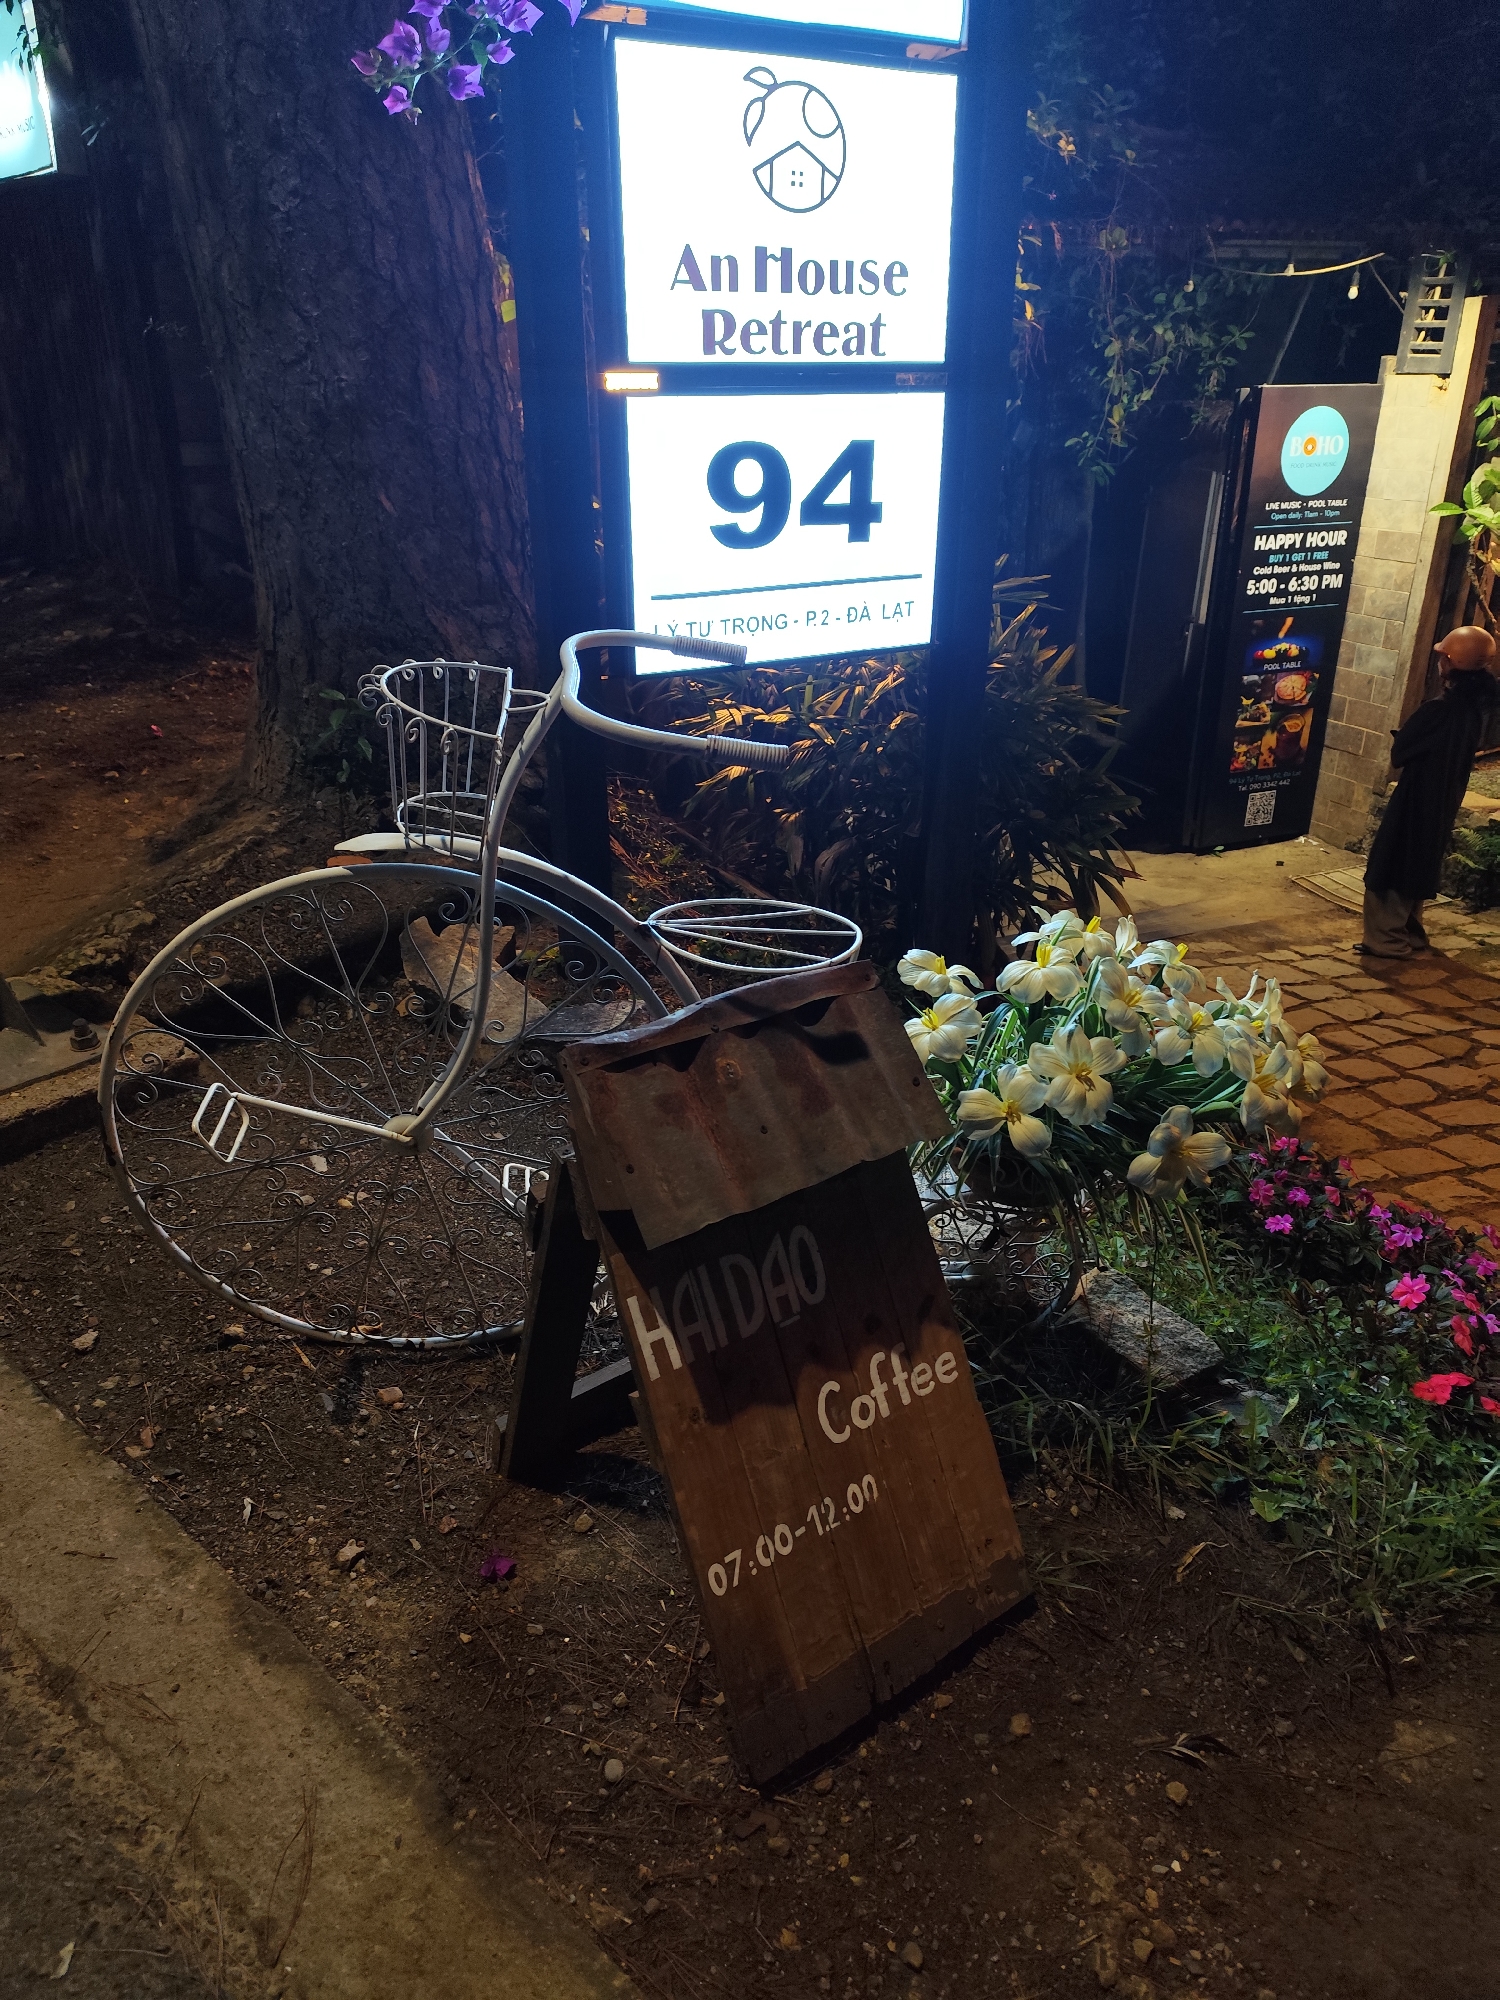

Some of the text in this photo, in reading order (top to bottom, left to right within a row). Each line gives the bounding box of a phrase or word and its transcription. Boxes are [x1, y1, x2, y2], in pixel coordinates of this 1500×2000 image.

[670, 243, 909, 297] An House
[701, 308, 887, 357] Retreat
[1289, 435, 1344, 457] BOHO
[706, 439, 883, 550] 94
[1265, 502, 1280, 511] LIVE
[1280, 501, 1302, 510] MUSIC
[1307, 500, 1326, 508] POOL
[1327, 498, 1349, 507] TABLE
[1270, 512, 1287, 521] Open
[1304, 510, 1318, 518] 11am
[1324, 509, 1340, 518] 10pm
[1253, 529, 1348, 551] HAPPY HOUR
[1253, 561, 1341, 575] Cold Beer & House Wine
[1268, 551, 1329, 563] BUY 1 GET 1 FREE
[1246, 577, 1278, 595] 5:00
[1287, 574, 1319, 592] 6:30
[1321, 573, 1344, 589] PM
[1269, 597, 1286, 605] Mua
[1287, 595, 1292, 603] 1
[721, 613, 788, 637] TRỌNG
[806, 609, 830, 628] P.2
[846, 600, 871, 622] ĐÀ
[881, 601, 915, 623] LẠT
[1263, 660, 1302, 671] POOL TABLE
[1262, 780, 1278, 789] 3342
[816, 1341, 960, 1444] Coffee
